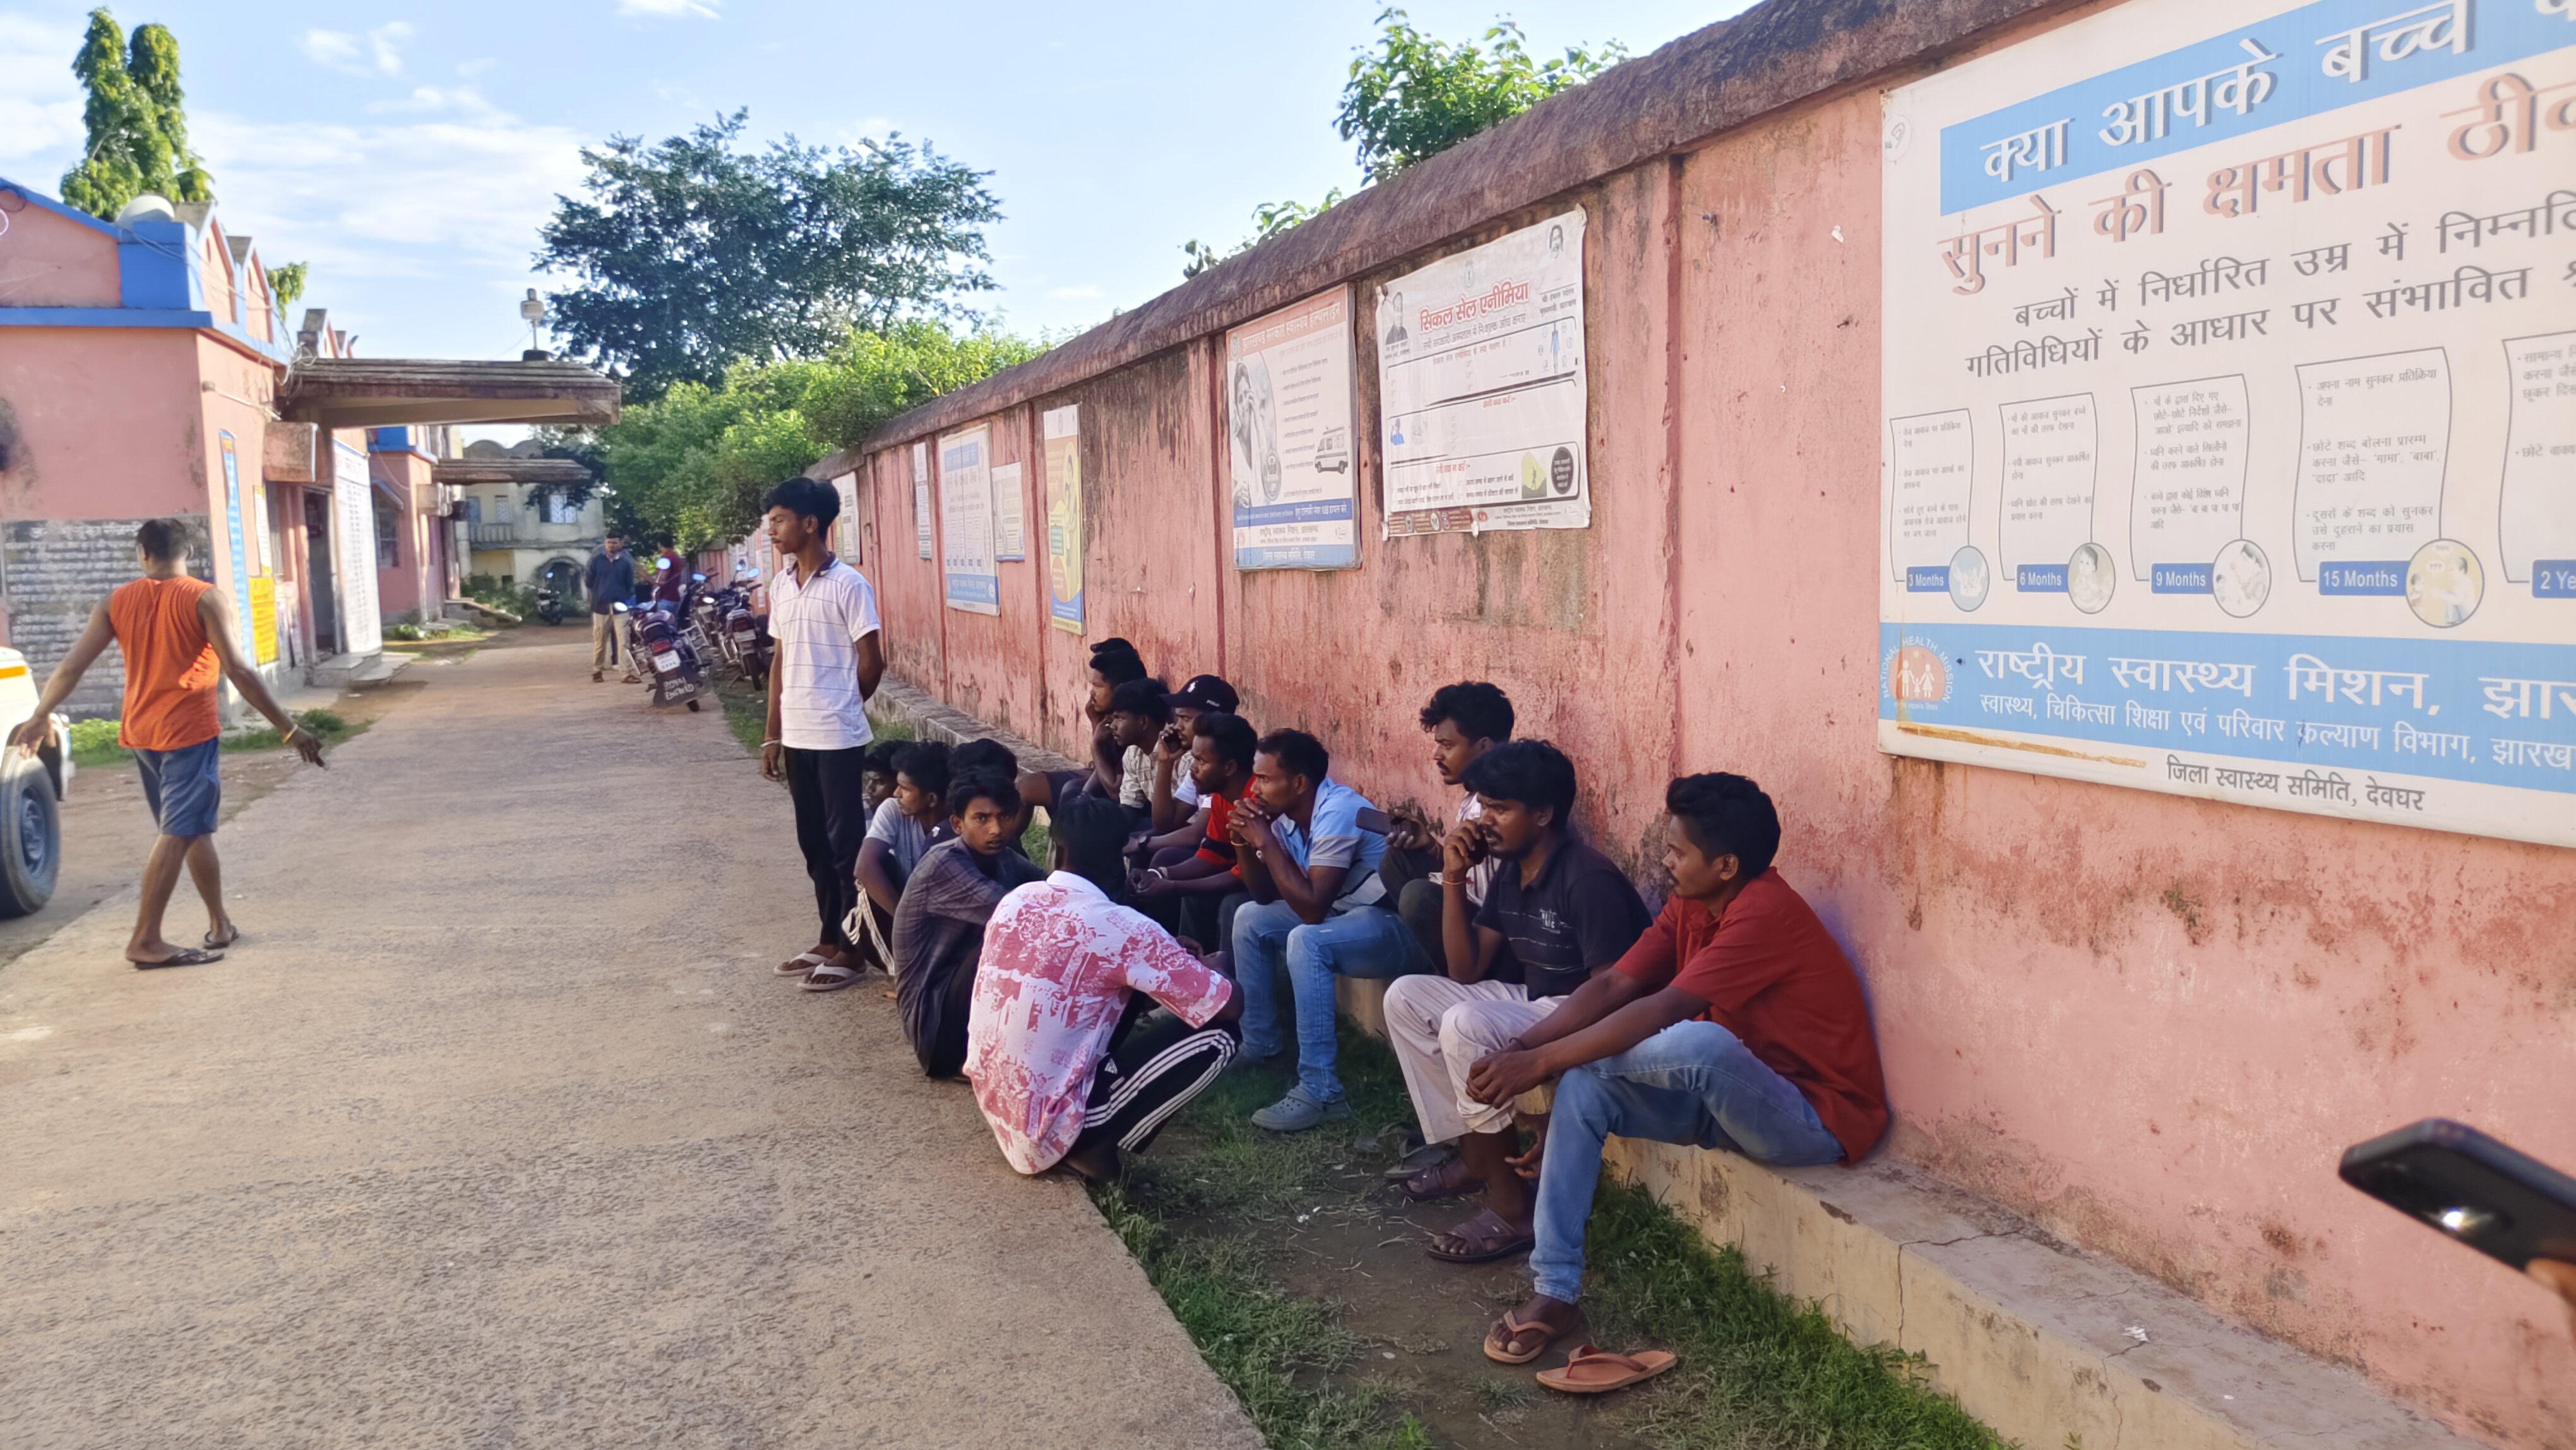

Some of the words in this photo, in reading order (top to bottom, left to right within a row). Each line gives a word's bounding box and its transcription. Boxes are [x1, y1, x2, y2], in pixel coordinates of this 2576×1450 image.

[1980, 117, 2075, 183] क्या
[2099, 38, 2284, 147] आपके
[2315, 0, 2476, 83] बच्च
[1937, 194, 2062, 296] सुनने
[2088, 169, 2173, 243] की
[2203, 124, 2401, 219] क्षमता
[2013, 287, 2078, 327] बच्चों
[2097, 279, 2119, 311] में
[2138, 256, 2270, 306] निर्धारित
[2291, 243, 2352, 276] उम्र
[2376, 222, 2409, 261] में
[1420, 309, 1453, 332] सिकल
[1455, 297, 1477, 320] सेल
[1479, 281, 1529, 314] एनीमिया
[1965, 328, 2102, 378] गतिविधियों
[2120, 319, 2150, 354] के
[2170, 309, 2270, 346] आधार
[2291, 298, 2340, 328] पर
[2362, 266, 2534, 318] संभावित
[2344, 378, 2360, 387] नाम
[2366, 374, 2394, 388] सुनकर
[2398, 368, 2436, 382] प्रतिक्रिया
[2318, 395, 2332, 406] देना
[2313, 439, 2331, 452] छोटे
[2337, 440, 2356, 450] शब्द
[2362, 436, 2391, 448] बोलना
[2313, 457, 2336, 467] करना
[2344, 469, 2365, 482] आदि
[2342, 505, 2351, 518] के
[2358, 508, 2376, 518] शब्द
[2382, 505, 2394, 517] को
[2402, 506, 2433, 520] सुनकर
[2312, 523, 2327, 535] उसे
[2369, 524, 2381, 533] का
[2387, 524, 2413, 534] प्रयास
[2312, 541, 2335, 551] करना
[1909, 574, 1913, 587] 3
[1916, 573, 1943, 586] Months
[2020, 572, 2025, 585] 6
[2029, 572, 2061, 585] Months
[2156, 573, 2162, 586] 9
[2166, 572, 2206, 587] Months
[2323, 571, 2339, 587] 15
[2344, 570, 2397, 587] Months
[2541, 572, 2550, 589] 2
[1902, 636, 1938, 652] HEALTH
[1880, 645, 1900, 698] NATIONAL
[1938, 651, 1953, 704] MISSION
[1975, 642, 2087, 690] राष्ट्रीय
[2108, 657, 2257, 697] स्वास्थ्य
[2283, 653, 2440, 716] मिशन,
[1980, 694, 2037, 720] स्वास्थ्य,
[2046, 693, 2116, 725] चिकित्सा
[2125, 700, 2170, 730] शिक्षा
[2179, 707, 2207, 735] एवं
[2218, 708, 2286, 741] परिवार
[2295, 721, 2381, 750] कल्याण
[2392, 721, 2476, 764] विभाग,
[2167, 753, 2209, 784] जिला
[2215, 767, 2279, 793] स्वास्थ्य
[2286, 769, 2358, 807] समिति,
[2366, 776, 2425, 811] देवघर
